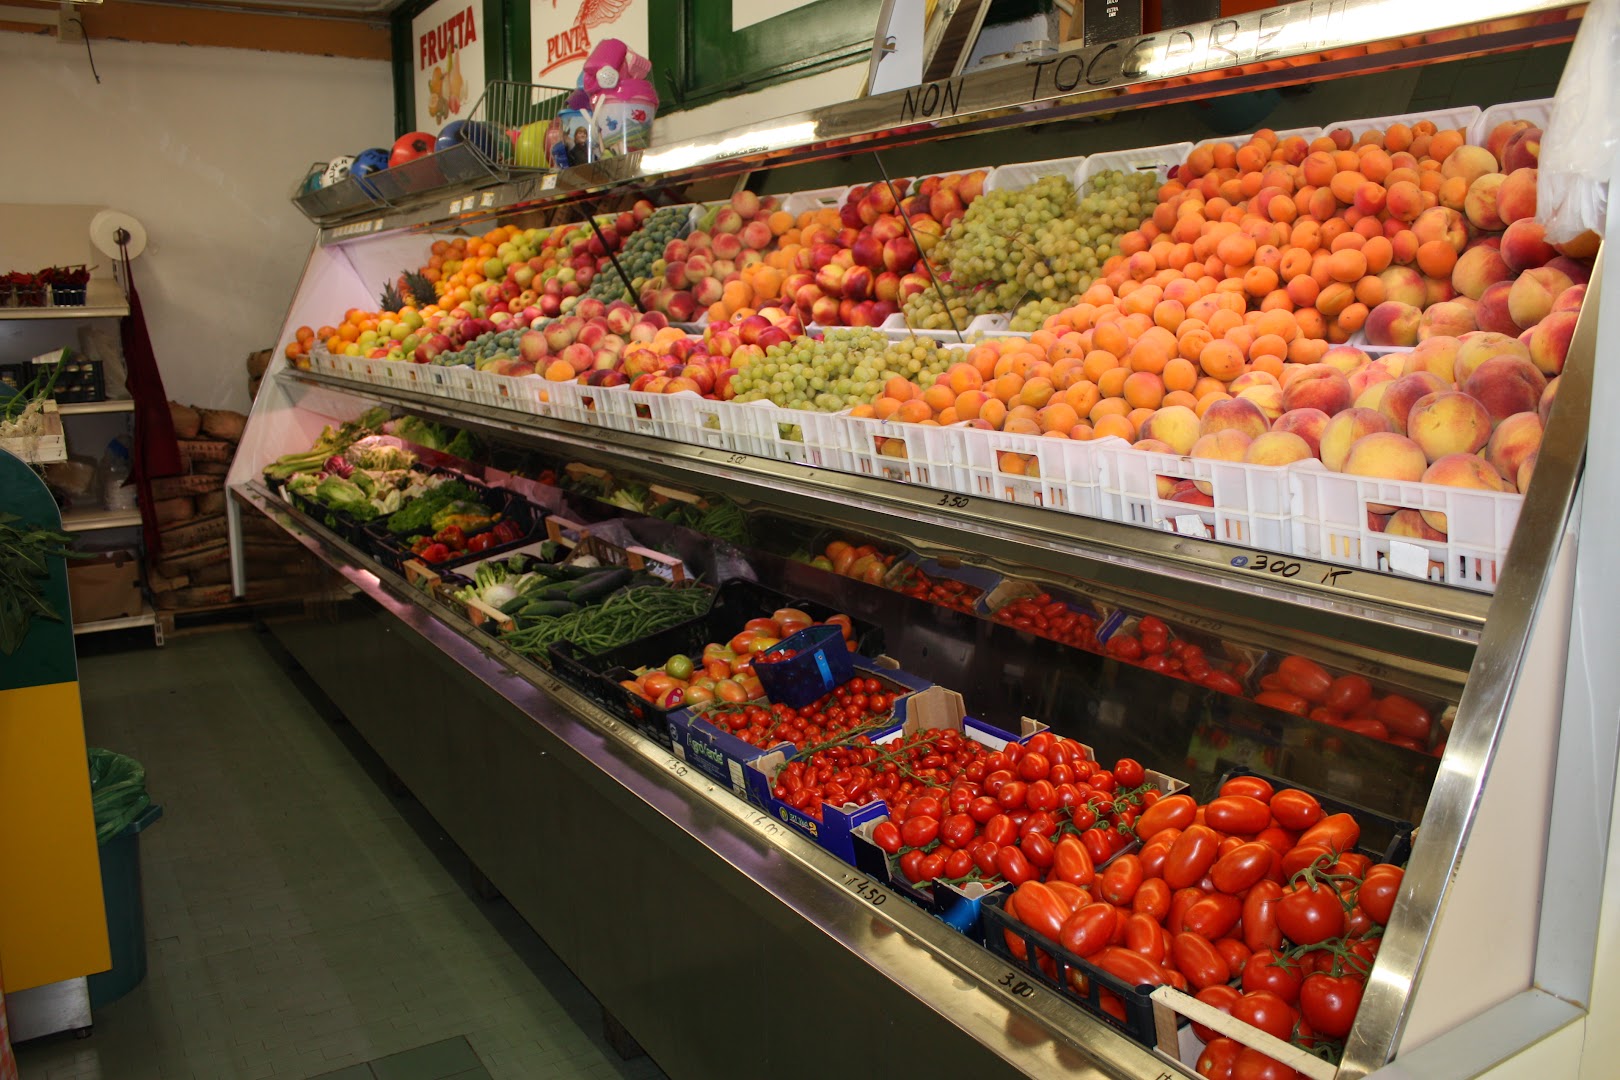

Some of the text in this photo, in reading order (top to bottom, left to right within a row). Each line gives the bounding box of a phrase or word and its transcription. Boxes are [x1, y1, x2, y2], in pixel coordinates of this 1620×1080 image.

[420, 5, 477, 71] FRUTTA
[547, 24, 591, 63] PUNTA
[900, 77, 964, 123] NON
[936, 494, 970, 508] 3.50
[1249, 555, 1301, 578] 300
[856, 880, 887, 906] 4.50
[997, 972, 1034, 998] 3.00
